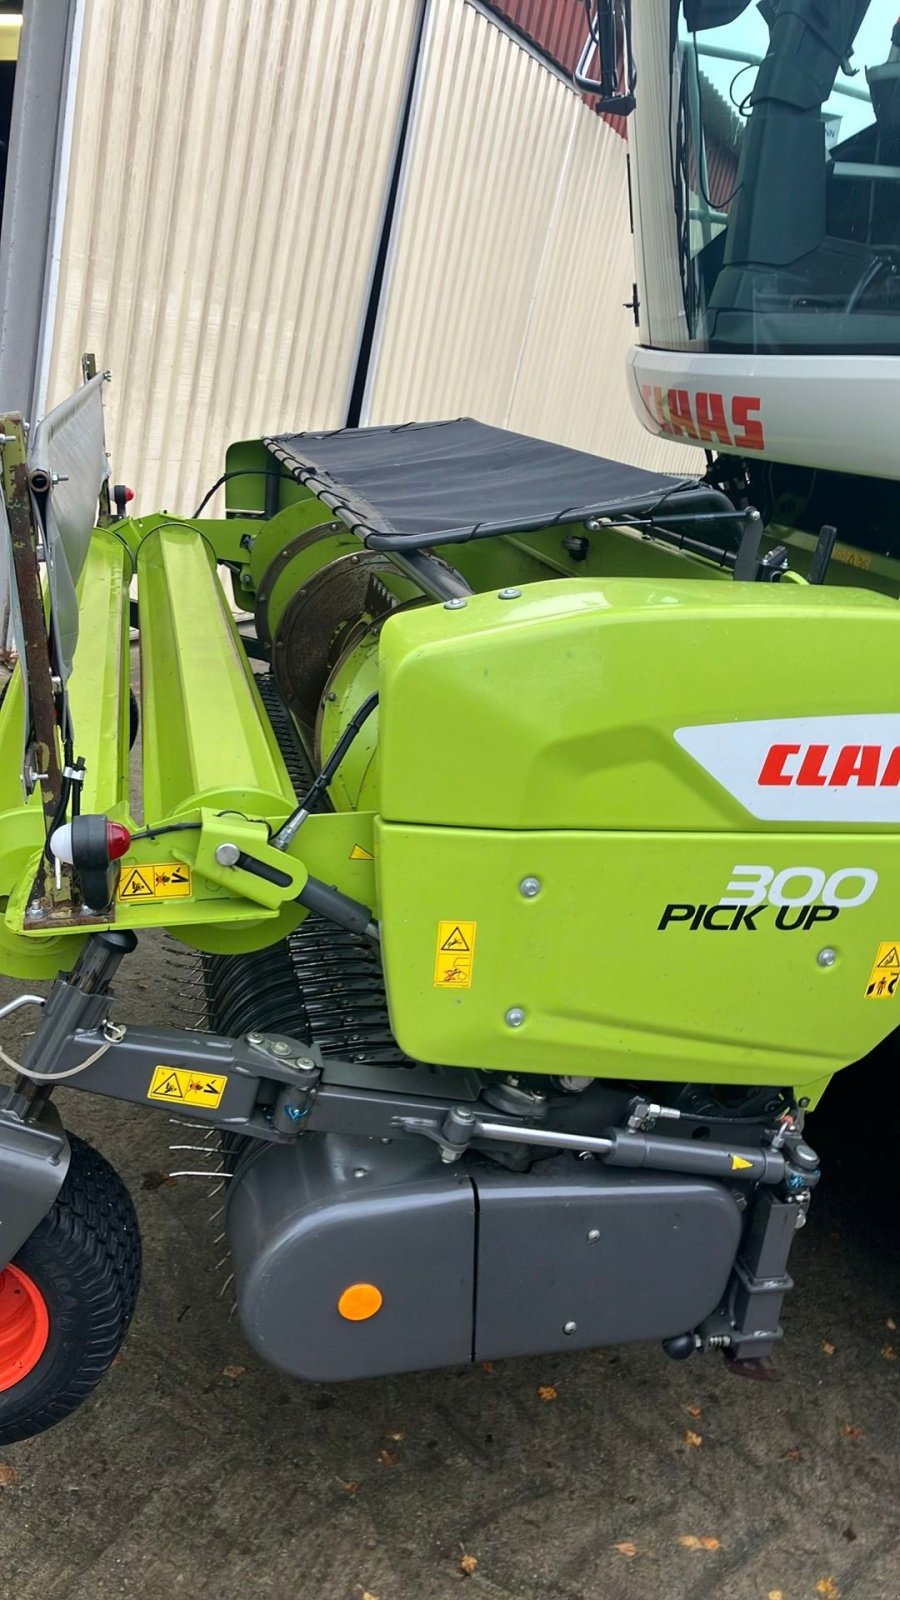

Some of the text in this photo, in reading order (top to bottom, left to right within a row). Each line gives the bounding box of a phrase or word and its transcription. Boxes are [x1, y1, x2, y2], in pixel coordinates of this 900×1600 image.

[719, 865, 878, 907] 300
[657, 904, 840, 930] PICK UP
